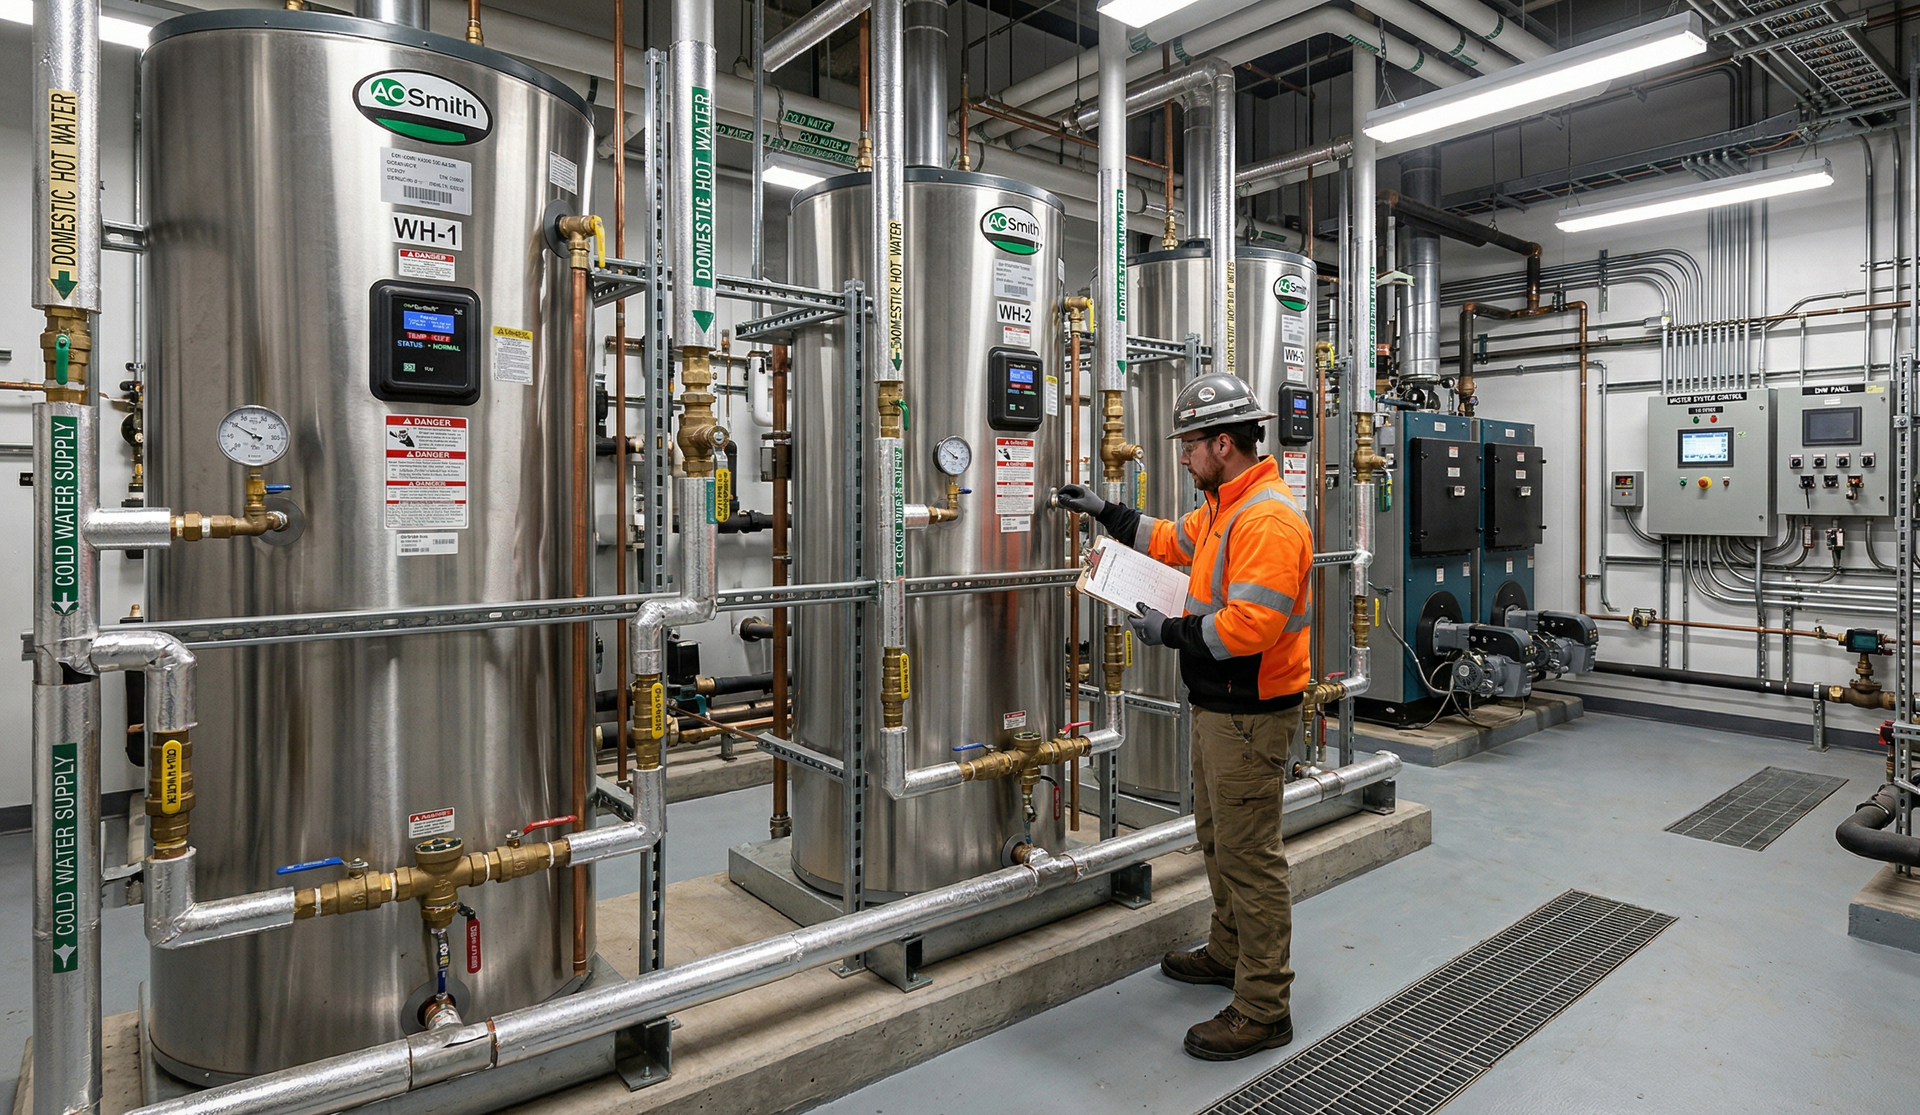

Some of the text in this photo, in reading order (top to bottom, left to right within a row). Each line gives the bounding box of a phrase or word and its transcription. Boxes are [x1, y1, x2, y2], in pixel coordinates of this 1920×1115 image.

[694, 93, 711, 151] WATER
[51, 93, 76, 266] DOMESTIC HOT WATER
[695, 157, 712, 192] HOT
[393, 216, 457, 246] WH-1
[890, 222, 902, 256] WATER
[890, 260, 903, 284] HOT
[998, 303, 1032, 324] WH-2
[397, 340, 462, 352] STATUS NORMAL
[414, 417, 452, 427] DANGER
[415, 451, 450, 459] DANGER
[54, 422, 75, 586] COLD WATER SUPPLY
[54, 756, 75, 936] COLD WATER SUPPLY
